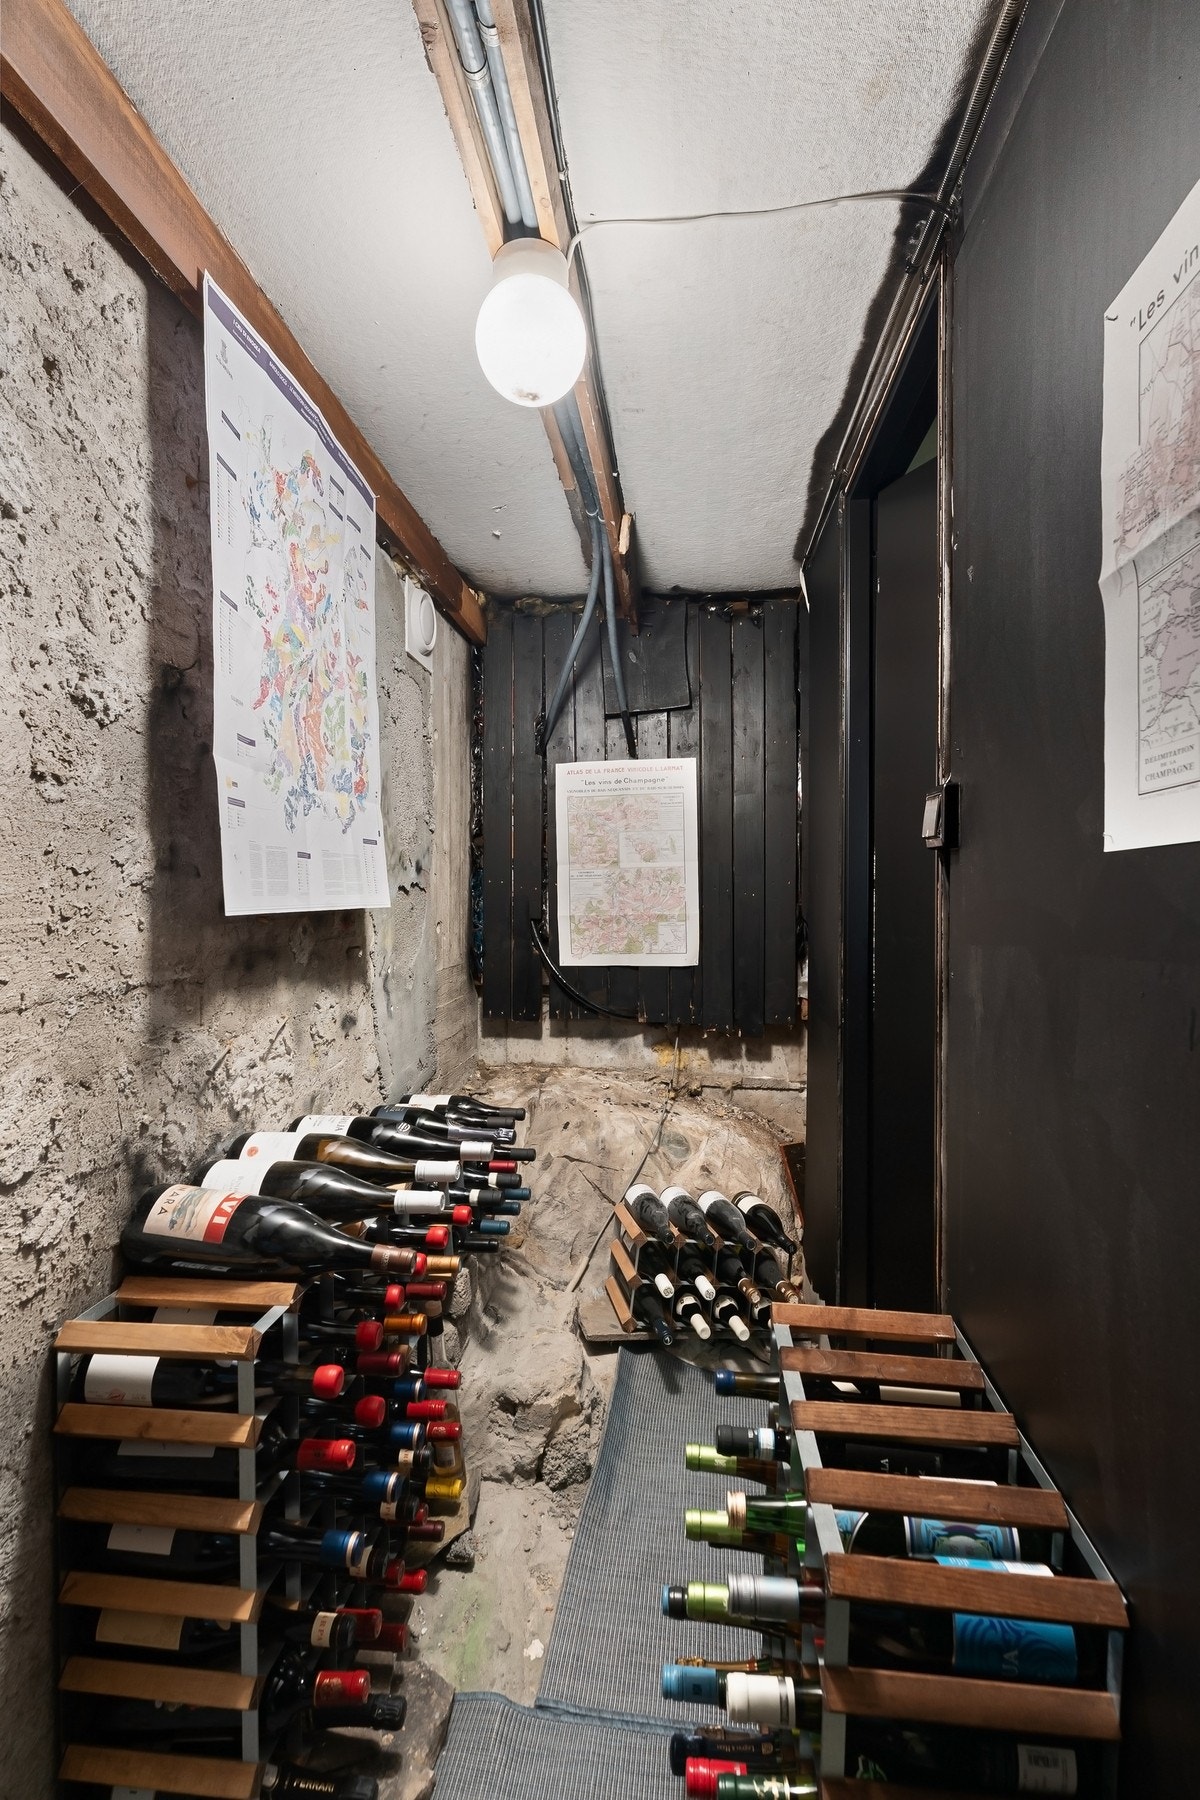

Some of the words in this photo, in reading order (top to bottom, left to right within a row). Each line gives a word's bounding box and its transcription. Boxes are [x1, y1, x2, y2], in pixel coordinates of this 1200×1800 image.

[1144, 762, 1195, 782] CHAMPAGNE
[614, 777, 623, 785] de
[292, 1778, 336, 1793] FERRARI
